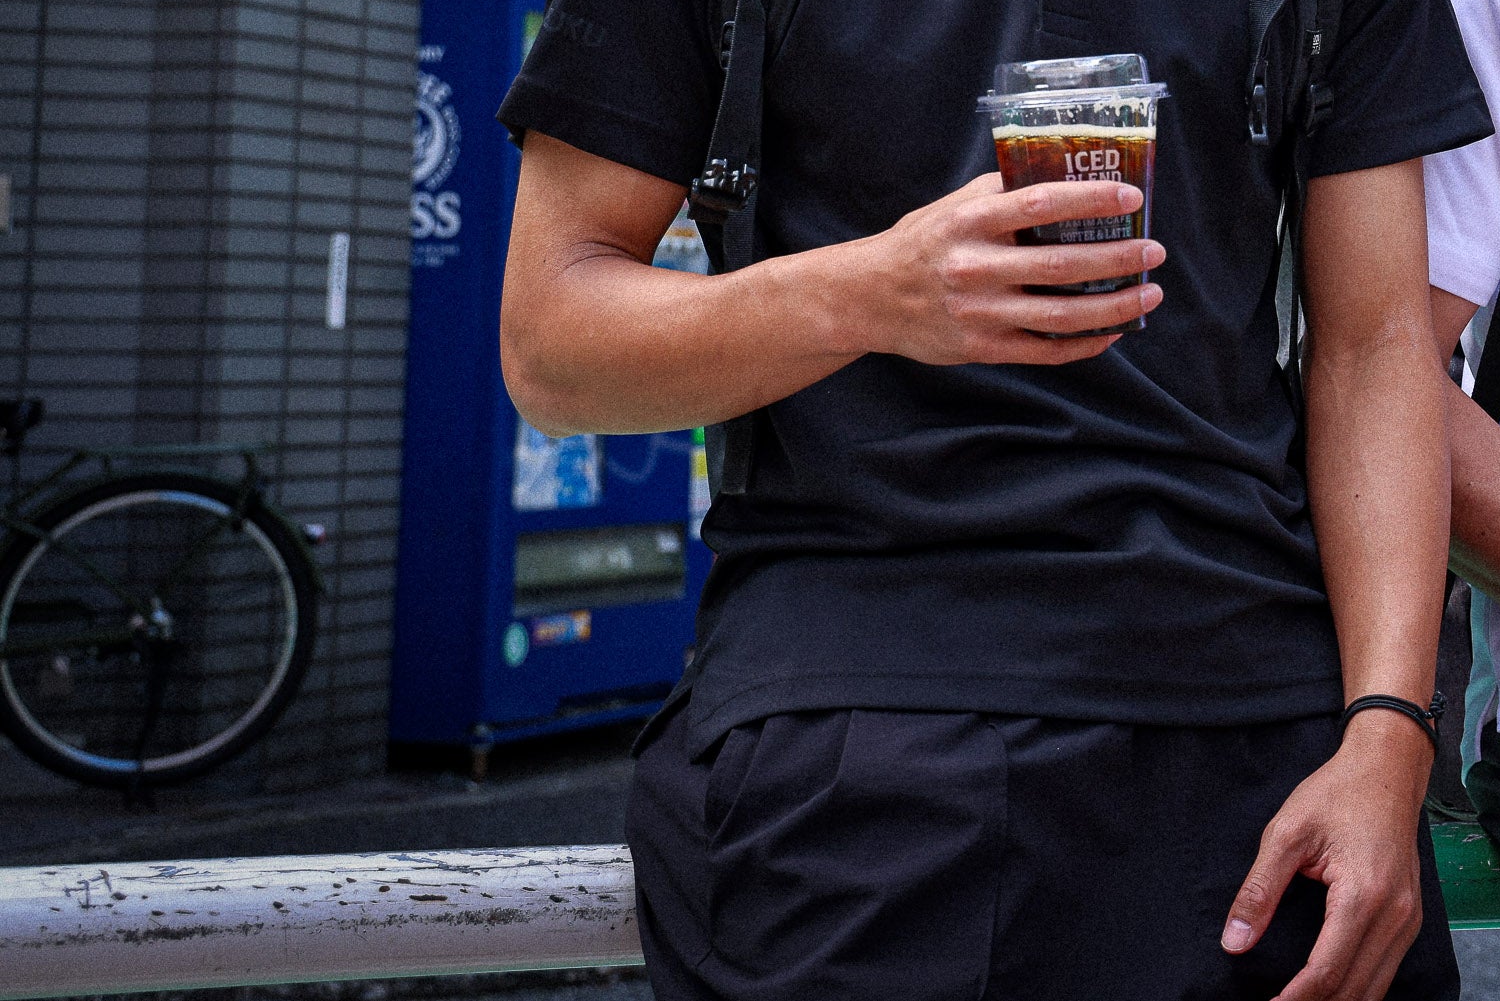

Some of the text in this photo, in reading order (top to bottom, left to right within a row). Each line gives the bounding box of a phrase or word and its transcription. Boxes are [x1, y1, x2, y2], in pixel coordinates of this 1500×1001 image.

[1065, 149, 1120, 173] ICED
[1060, 230, 1095, 243] COFFEE
[1105, 226, 1132, 240] LATTE
